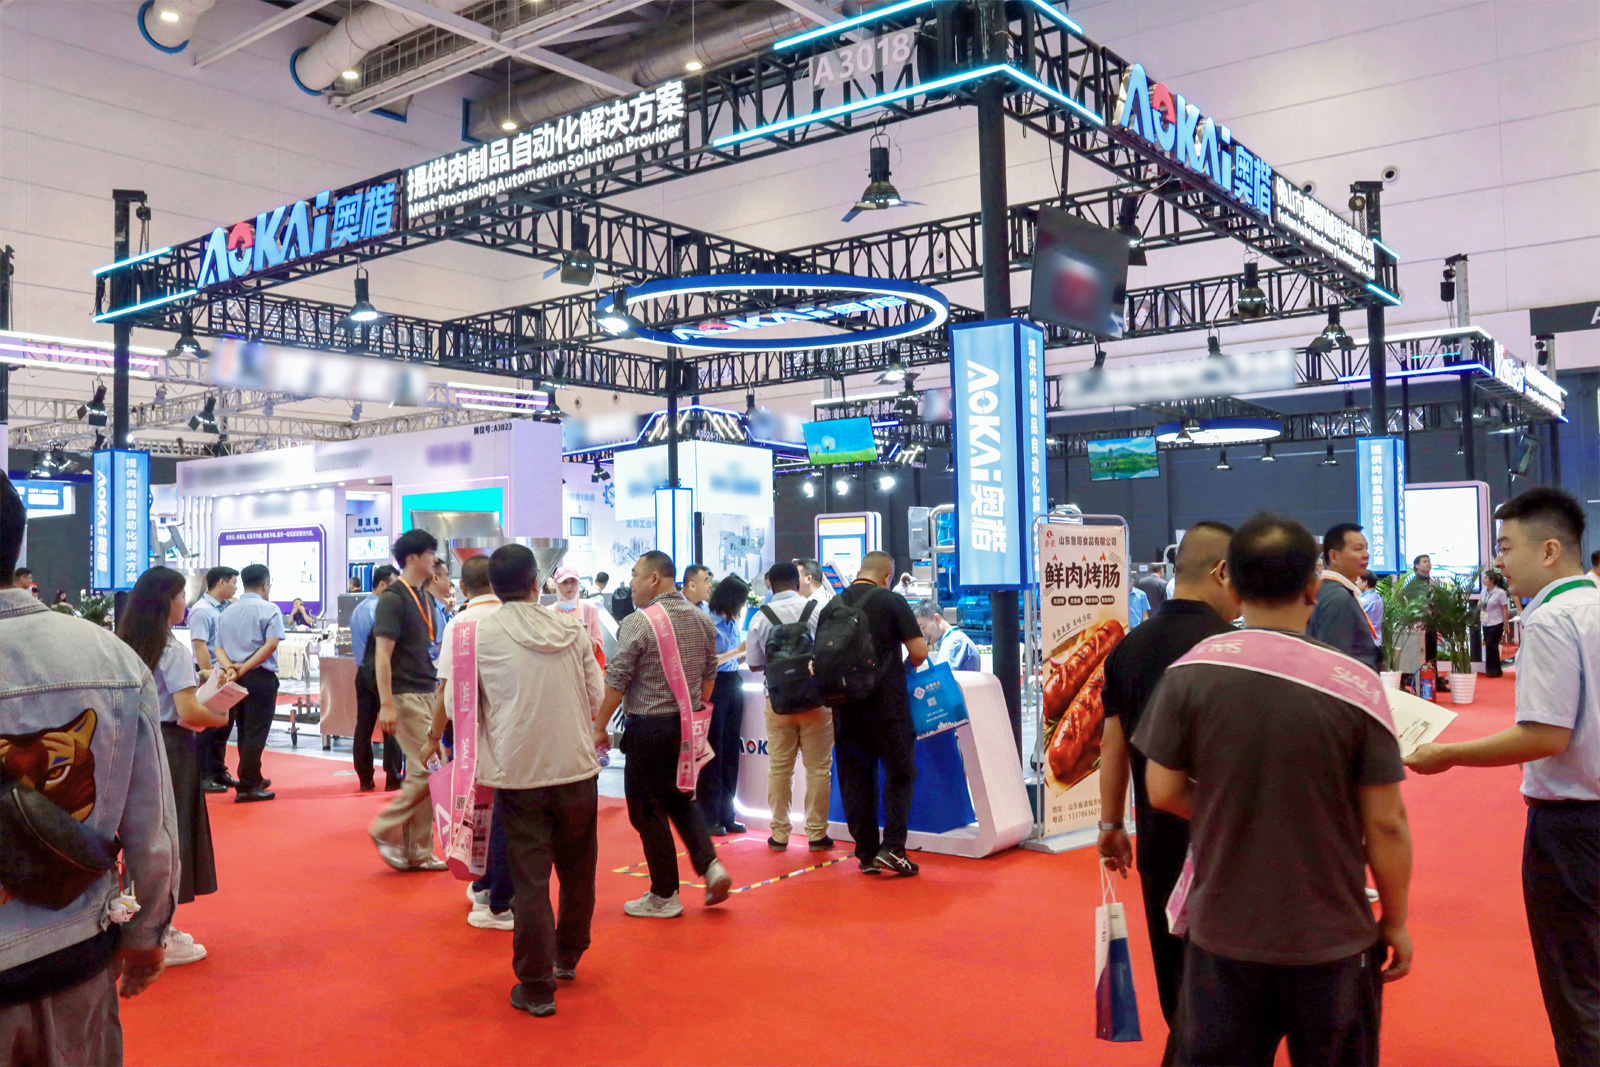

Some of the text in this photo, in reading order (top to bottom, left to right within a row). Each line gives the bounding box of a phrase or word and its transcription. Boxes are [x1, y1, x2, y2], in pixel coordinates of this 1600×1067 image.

[814, 33, 910, 86] A3018
[407, 80, 685, 200] 提供肉制品自动化解决方案
[496, 159, 566, 190] Automation
[567, 139, 623, 170] Solution
[625, 122, 681, 151] Provider
[1234, 145, 1272, 215] 奥楷
[331, 182, 396, 248] 奥楷
[126, 458, 137, 582] 提供肉制品自动化解决方案
[970, 484, 1006, 553] 奥楷
[1370, 444, 1384, 566] 提供肉制品自动化解决方案
[1045, 562, 1120, 589] 鲜肉烤肠
